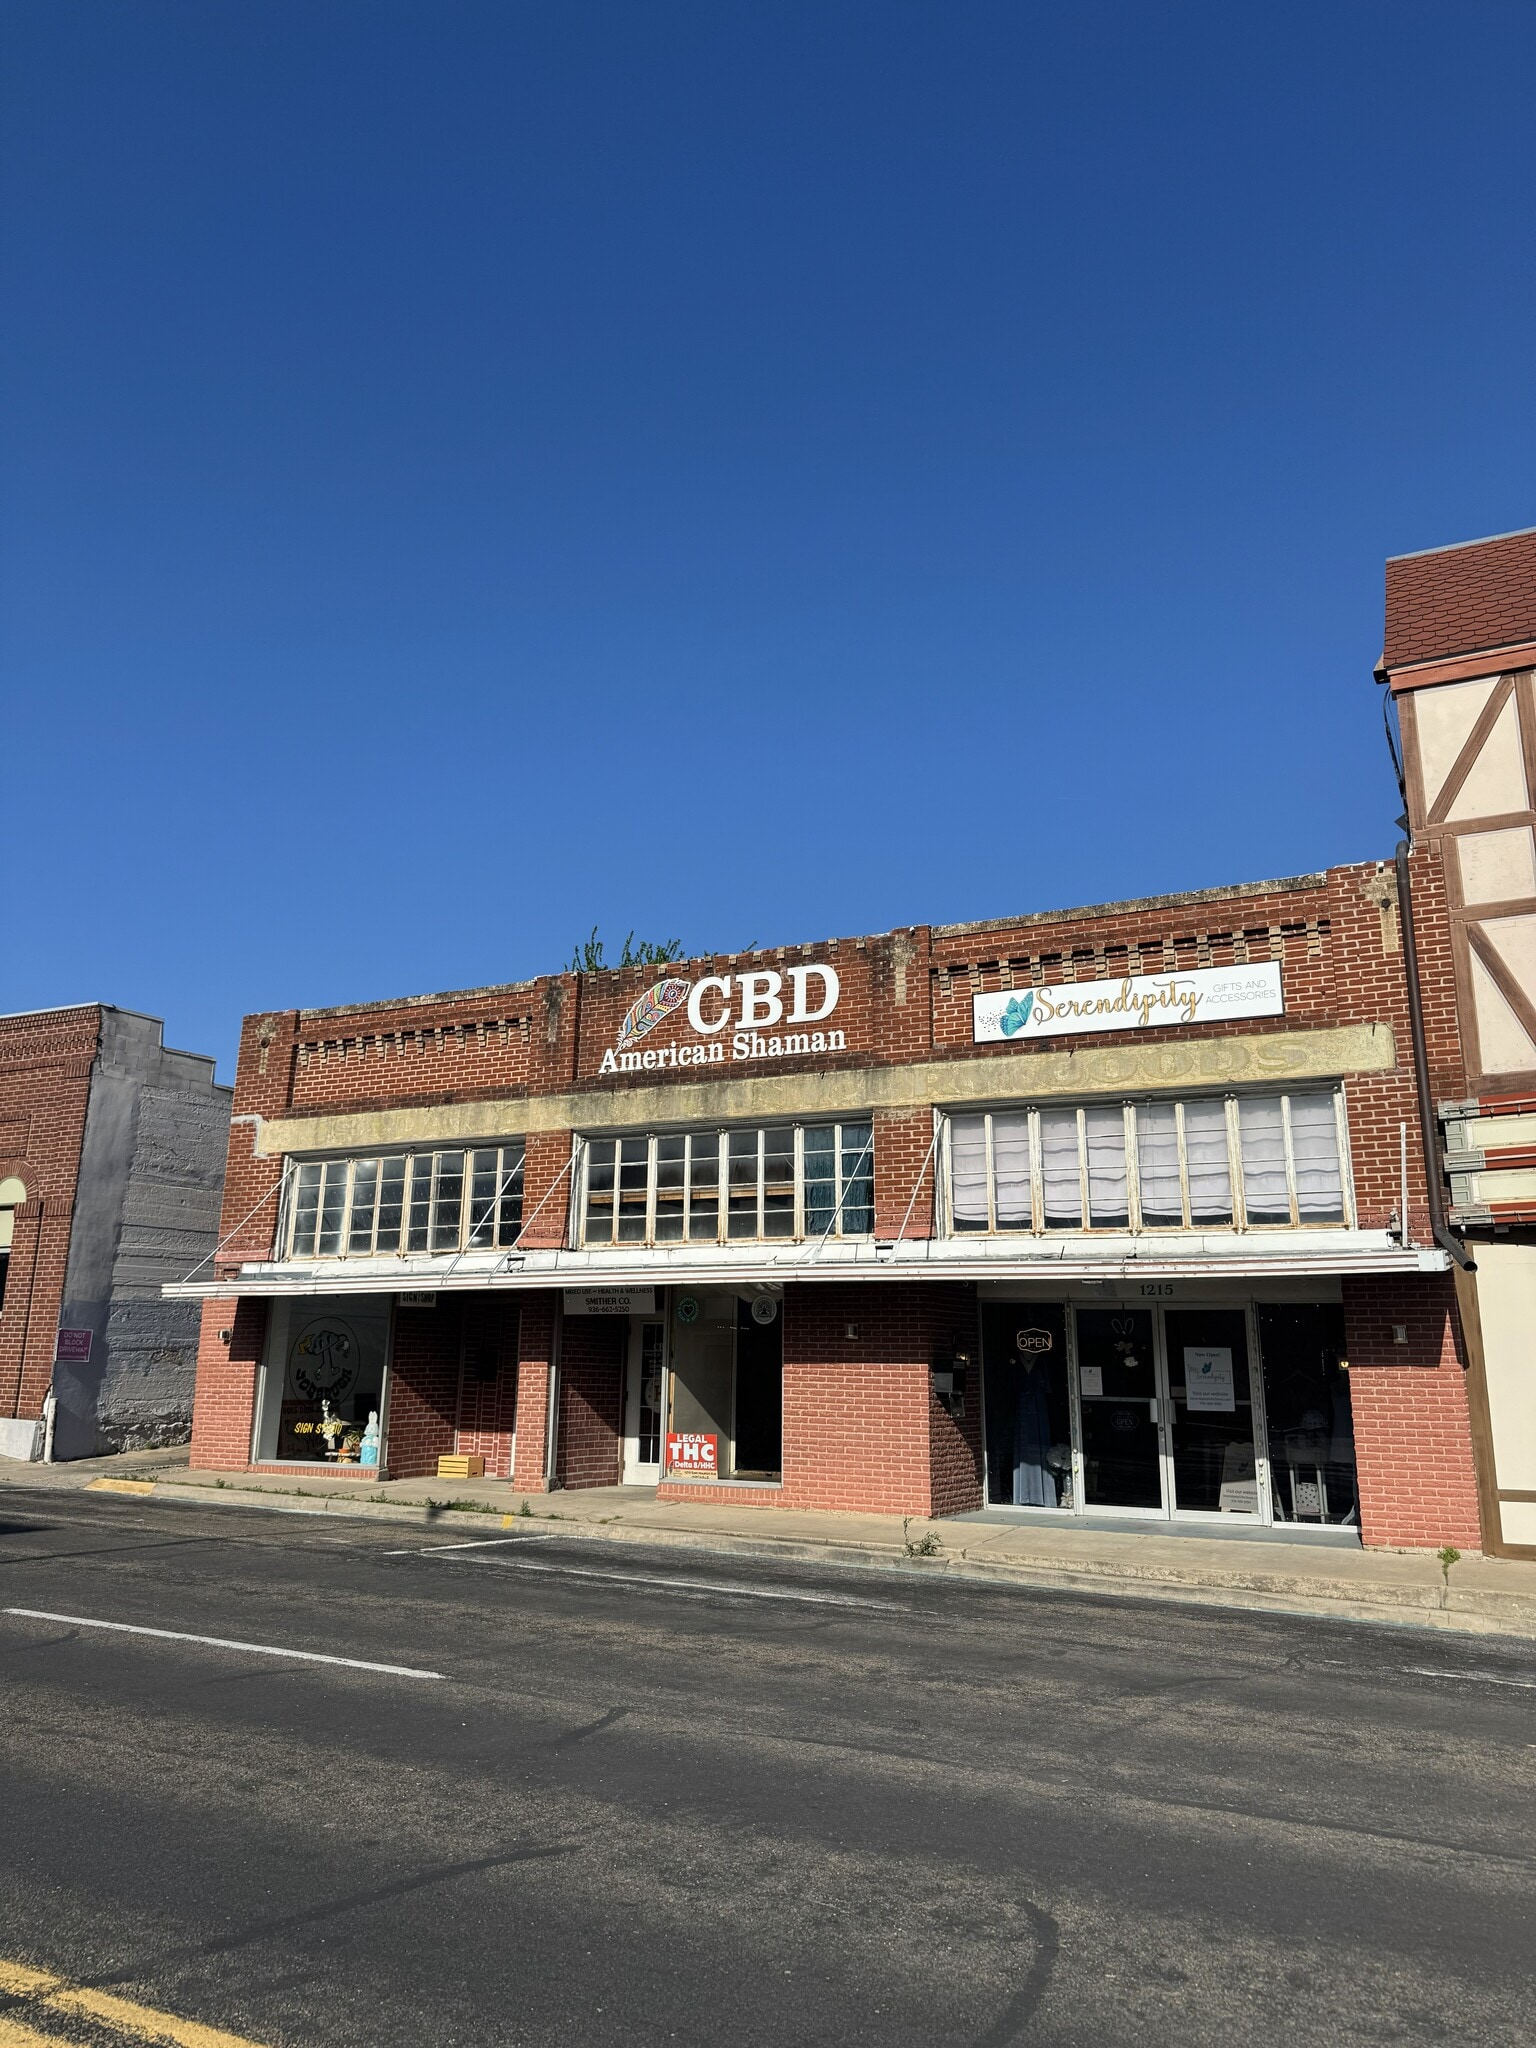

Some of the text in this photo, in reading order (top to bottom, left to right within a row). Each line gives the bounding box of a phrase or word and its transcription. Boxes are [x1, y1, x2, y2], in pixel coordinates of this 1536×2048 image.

[1213, 979, 1267, 993] GIFTS AND
[687, 963, 840, 1035] CBD
[1032, 977, 1204, 1026] Serendipity
[1205, 989, 1277, 1004] ACCESSORIES
[598, 1029, 846, 1074] American Shaman
[1140, 1284, 1174, 1296] 1215
[585, 1297, 632, 1306] SMITHER CO.
[1019, 1337, 1051, 1348] OPEN
[1116, 1415, 1134, 1426] OPEN
[294, 1422, 314, 1434] SIGN
[677, 1433, 708, 1444] LEGAL
[669, 1442, 715, 1462] THC
[675, 1460, 715, 1470] Delta 8/HHC
